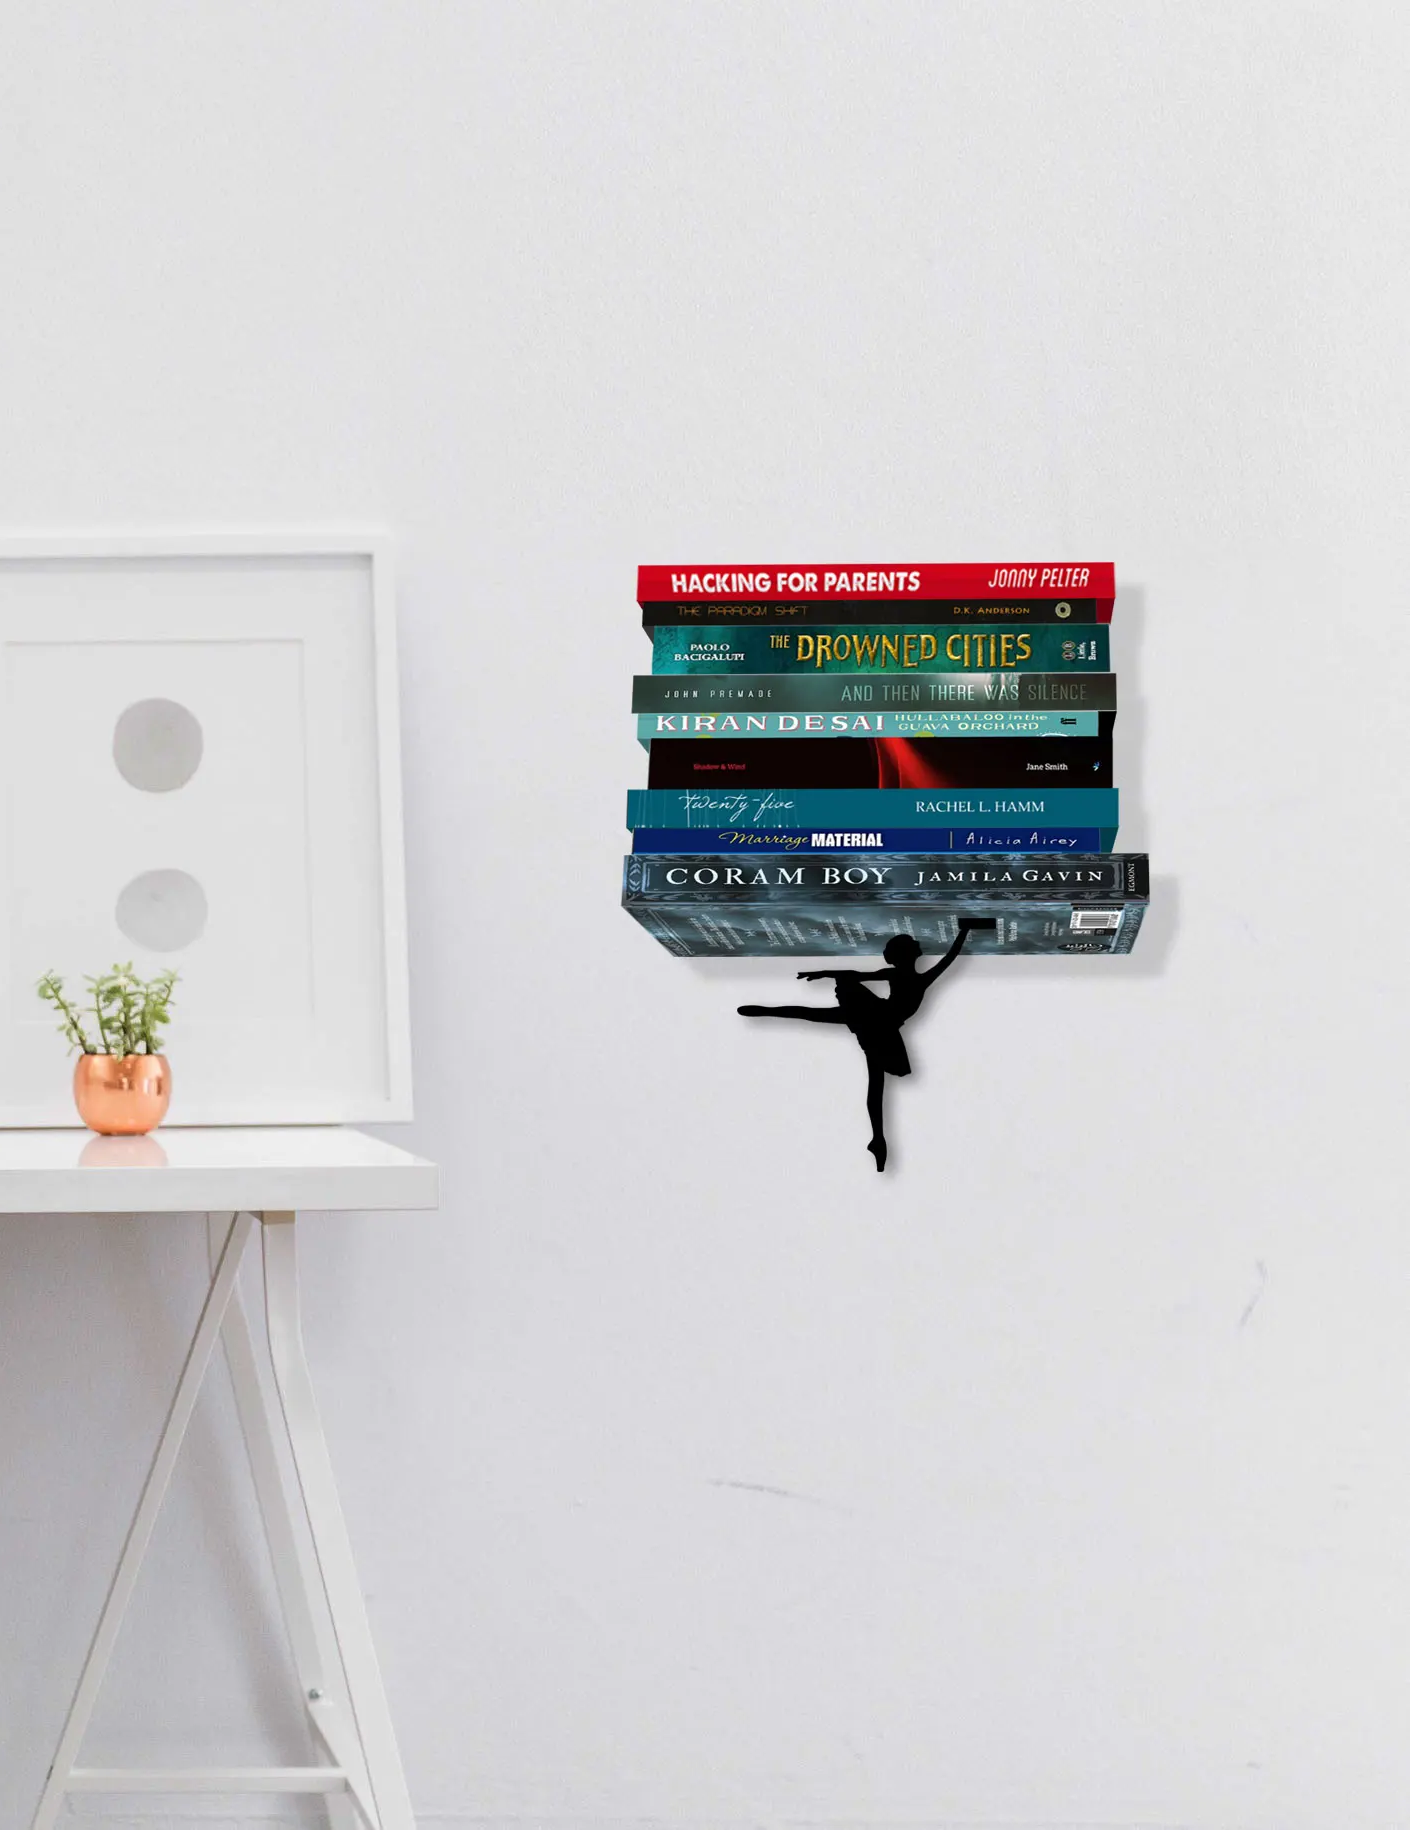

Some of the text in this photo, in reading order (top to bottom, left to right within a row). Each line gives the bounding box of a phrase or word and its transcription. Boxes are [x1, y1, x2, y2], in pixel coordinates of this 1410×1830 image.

[671, 571, 921, 593] HACKING FOR PARENTS
[988, 567, 1090, 588] JONNY PELTER
[677, 605, 702, 617] THE
[774, 605, 809, 616] SHIFT
[953, 606, 1030, 615] D.K. ANDERSON
[690, 643, 730, 651] PAOLO
[769, 633, 1032, 669] THE DROWNED CITIES
[674, 653, 745, 661] BACIGALUPI
[664, 689, 772, 699] JOHN PREMADE
[841, 684, 1087, 702] AND THEN THERE WAS SILENCE
[655, 714, 885, 732] KIRAN DESAI
[894, 713, 1004, 721] HULLABALOO
[898, 722, 1039, 731] GUAVA ORCHARD
[1026, 762, 1069, 771] Jane Smith
[915, 801, 1045, 813] RACHEL L. HAMM
[718, 831, 884, 851] Marriage MATERIAL
[965, 832, 1078, 847] Alicia Airey
[665, 866, 893, 886] CORAM BOY
[914, 869, 1104, 886] JAMILA GAVIN
[1127, 862, 1135, 892] EGMONT
